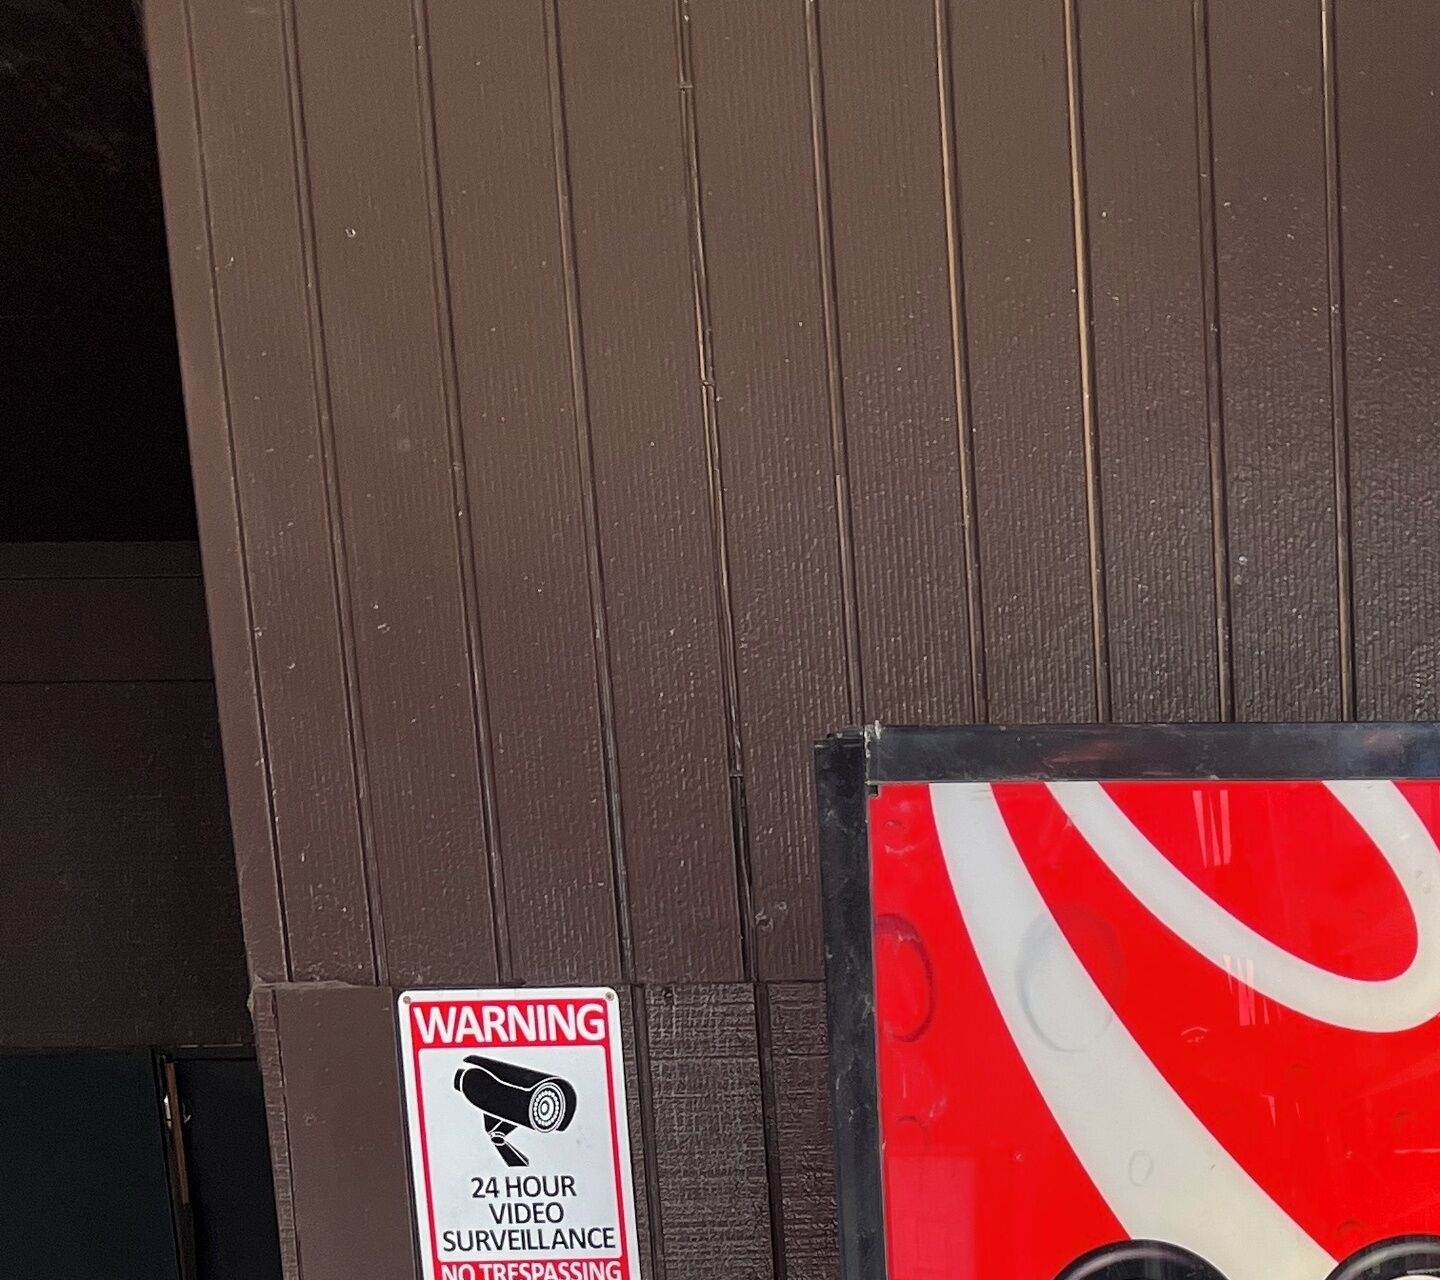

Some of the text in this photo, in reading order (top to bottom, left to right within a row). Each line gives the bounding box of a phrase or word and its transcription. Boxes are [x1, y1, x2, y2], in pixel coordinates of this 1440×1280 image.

[414, 1004, 606, 1043] WARNING
[471, 1176, 576, 1198] 24 HOUR
[489, 1202, 565, 1225] VIDEO
[442, 1227, 616, 1253] SURVEILLANCE
